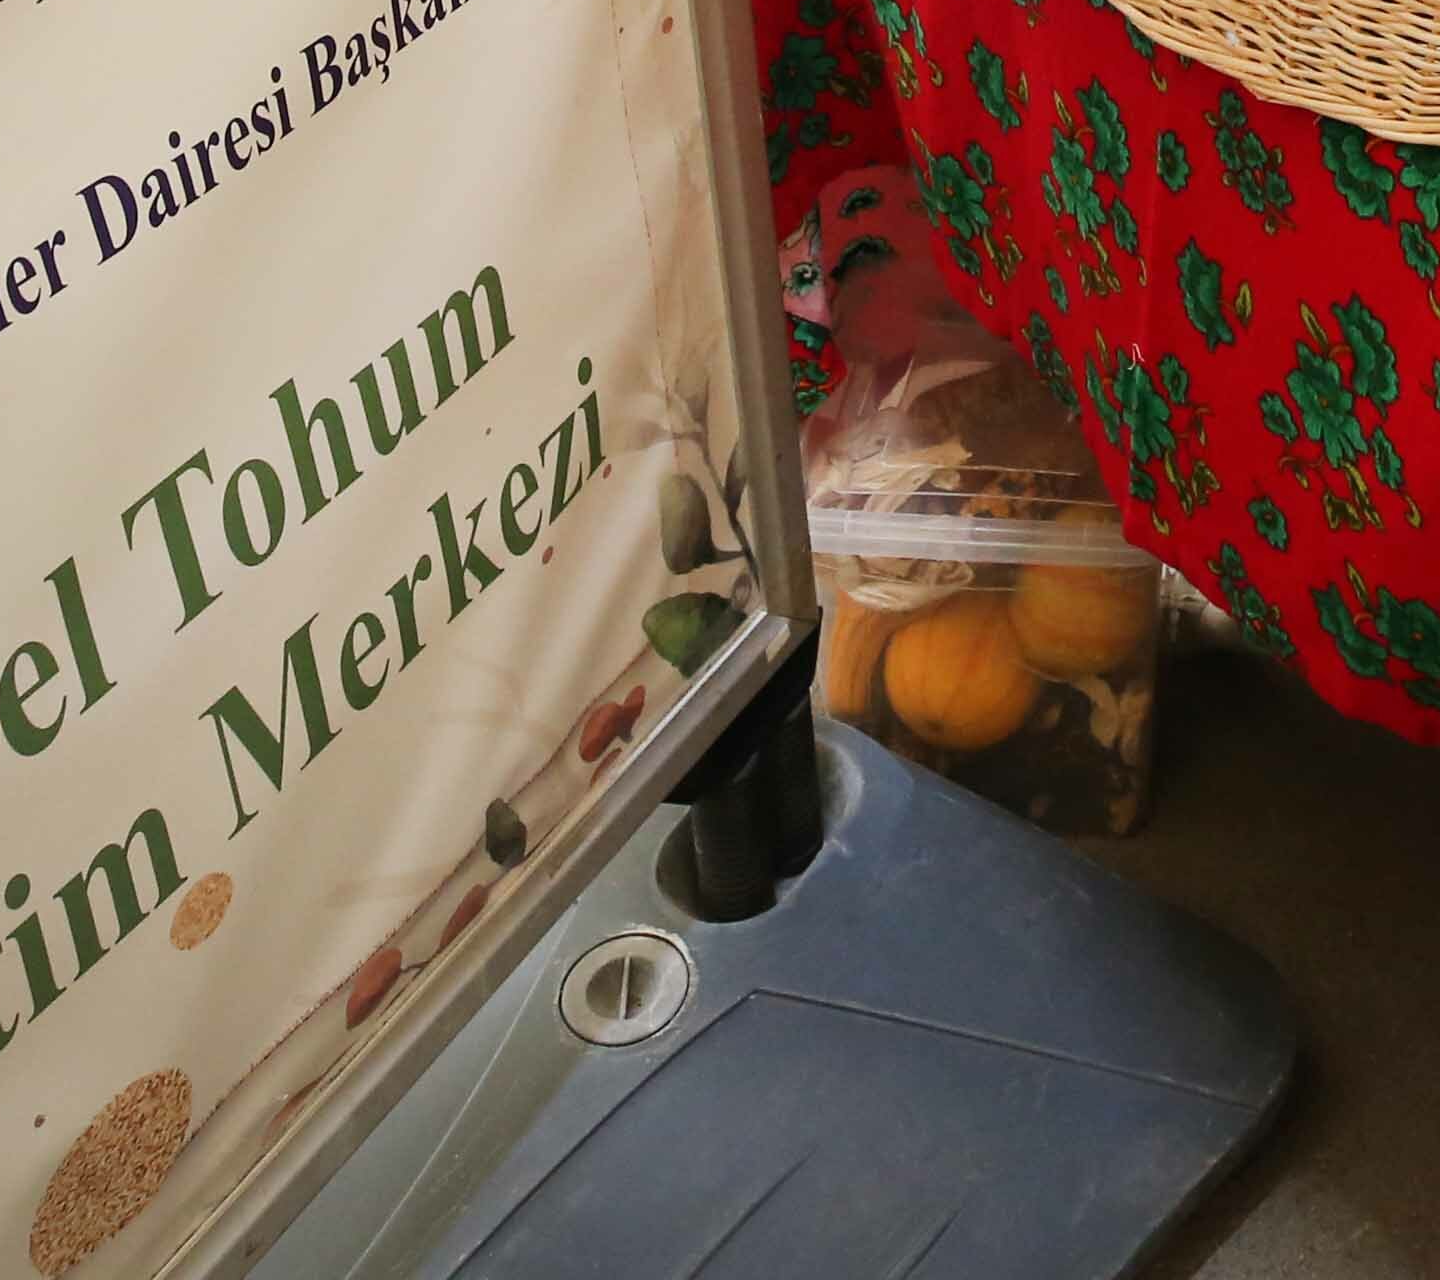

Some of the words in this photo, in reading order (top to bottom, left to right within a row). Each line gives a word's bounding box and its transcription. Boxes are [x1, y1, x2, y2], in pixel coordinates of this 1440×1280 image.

[75, 66, 296, 266] Dairesi
[119, 264, 516, 635] Tohum
[196, 355, 608, 842] Merkezi
